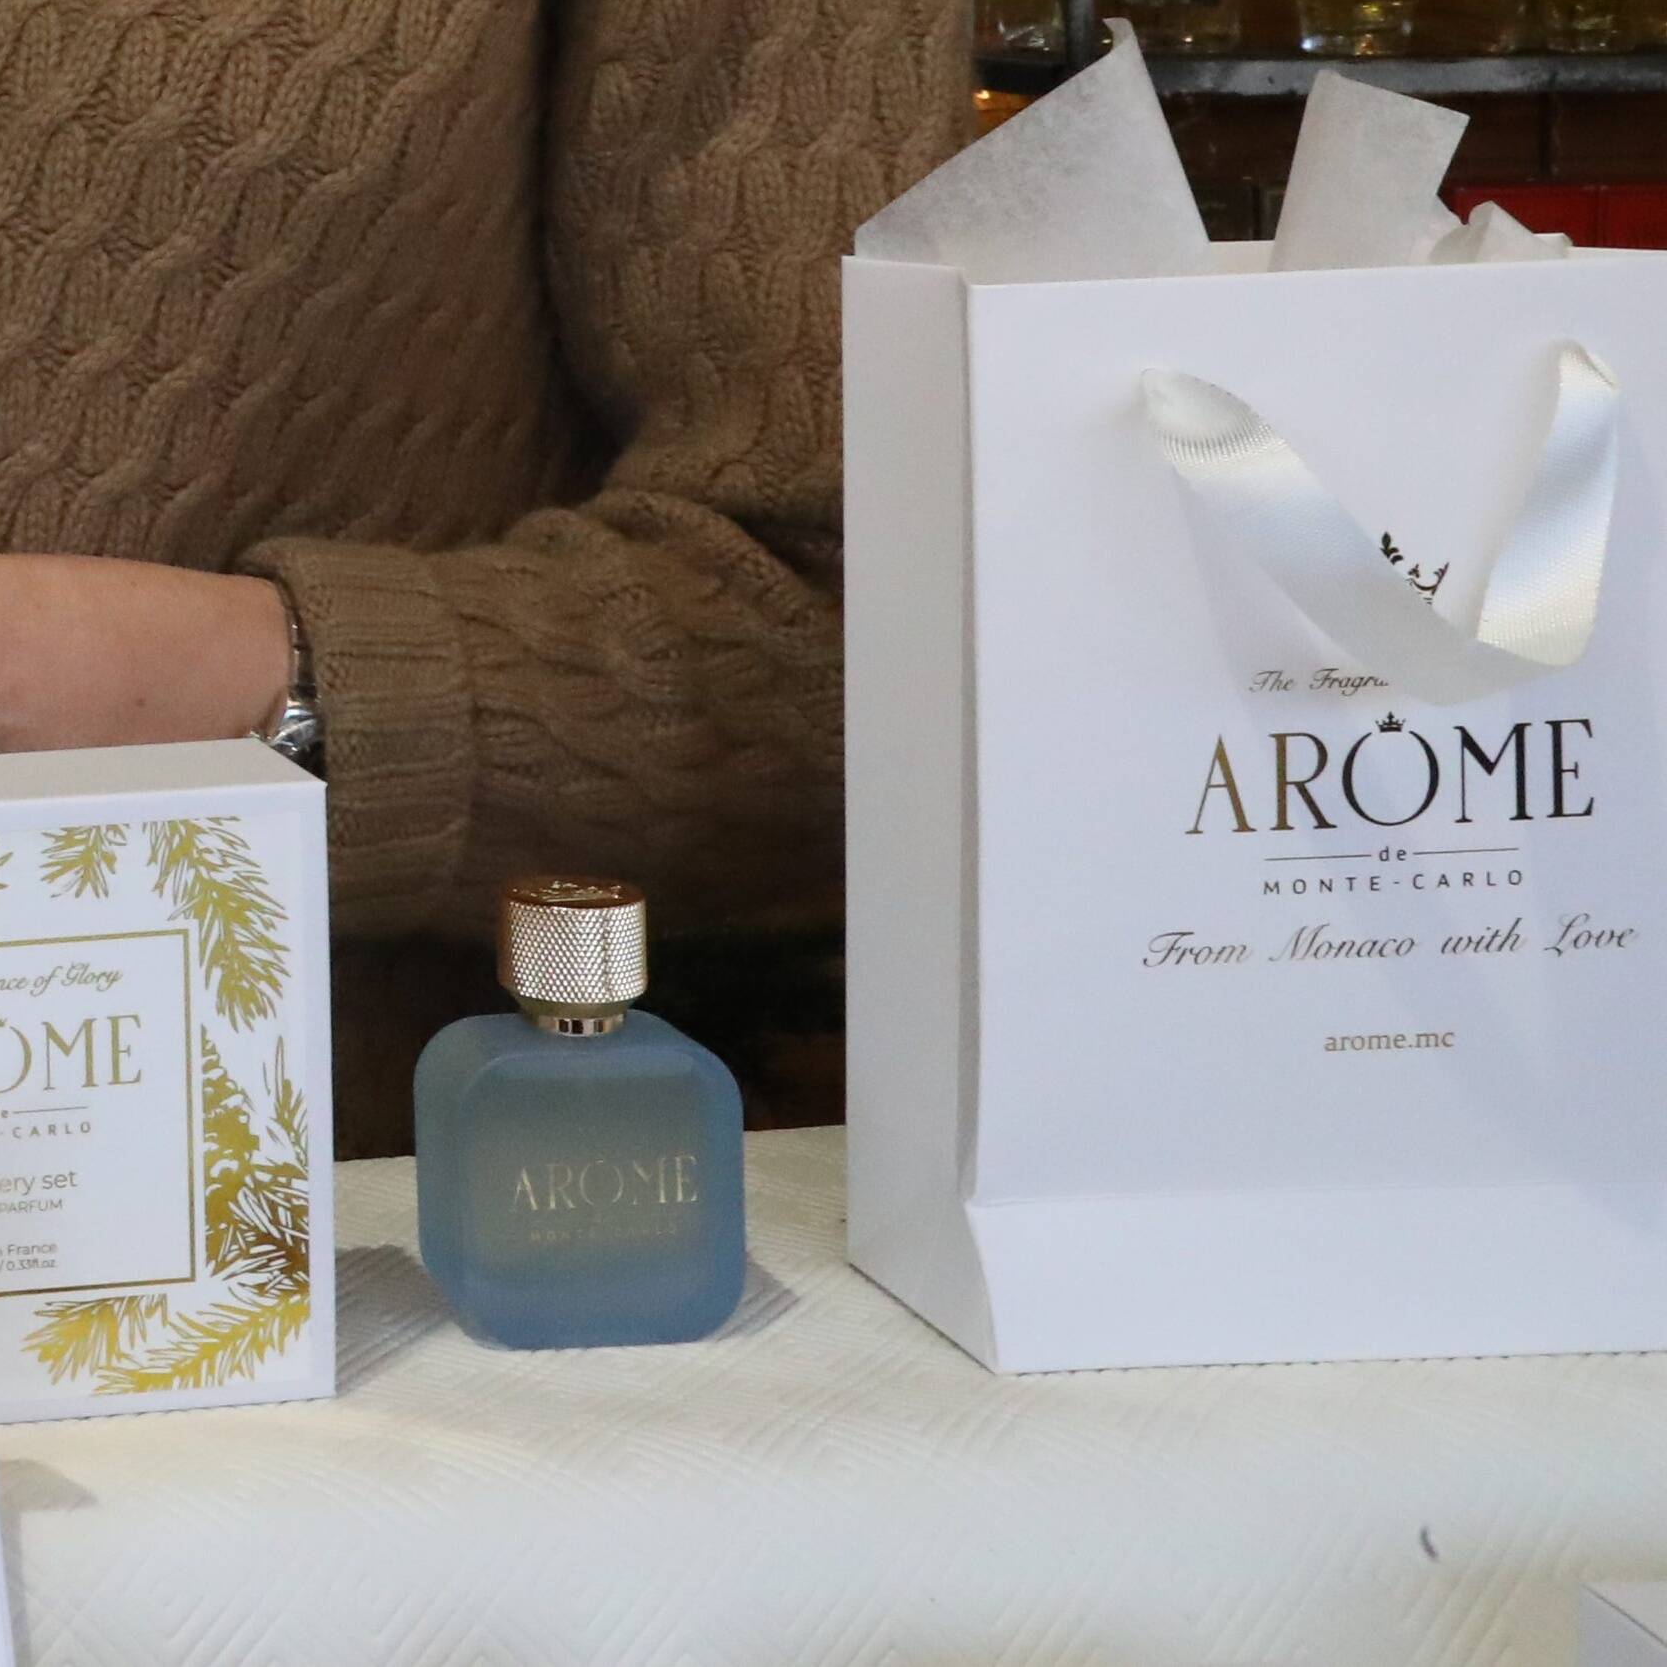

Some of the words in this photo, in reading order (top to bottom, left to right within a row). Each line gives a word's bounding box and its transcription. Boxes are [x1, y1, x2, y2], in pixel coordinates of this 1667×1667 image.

[1249, 670, 1294, 693] The
[1378, 845, 1406, 862] de
[1263, 869, 1524, 896] MONTE-CARLO
[1142, 930, 1251, 969] From
[1269, 922, 1418, 964] Monaco
[1440, 918, 1524, 956] with
[1544, 912, 1637, 958] Love
[30, 966, 63, 996] of
[61, 962, 123, 991] Glory
[1323, 1029, 1455, 1053] arome.mc
[42, 1170, 78, 1190] set
[7, 1242, 58, 1256] France
